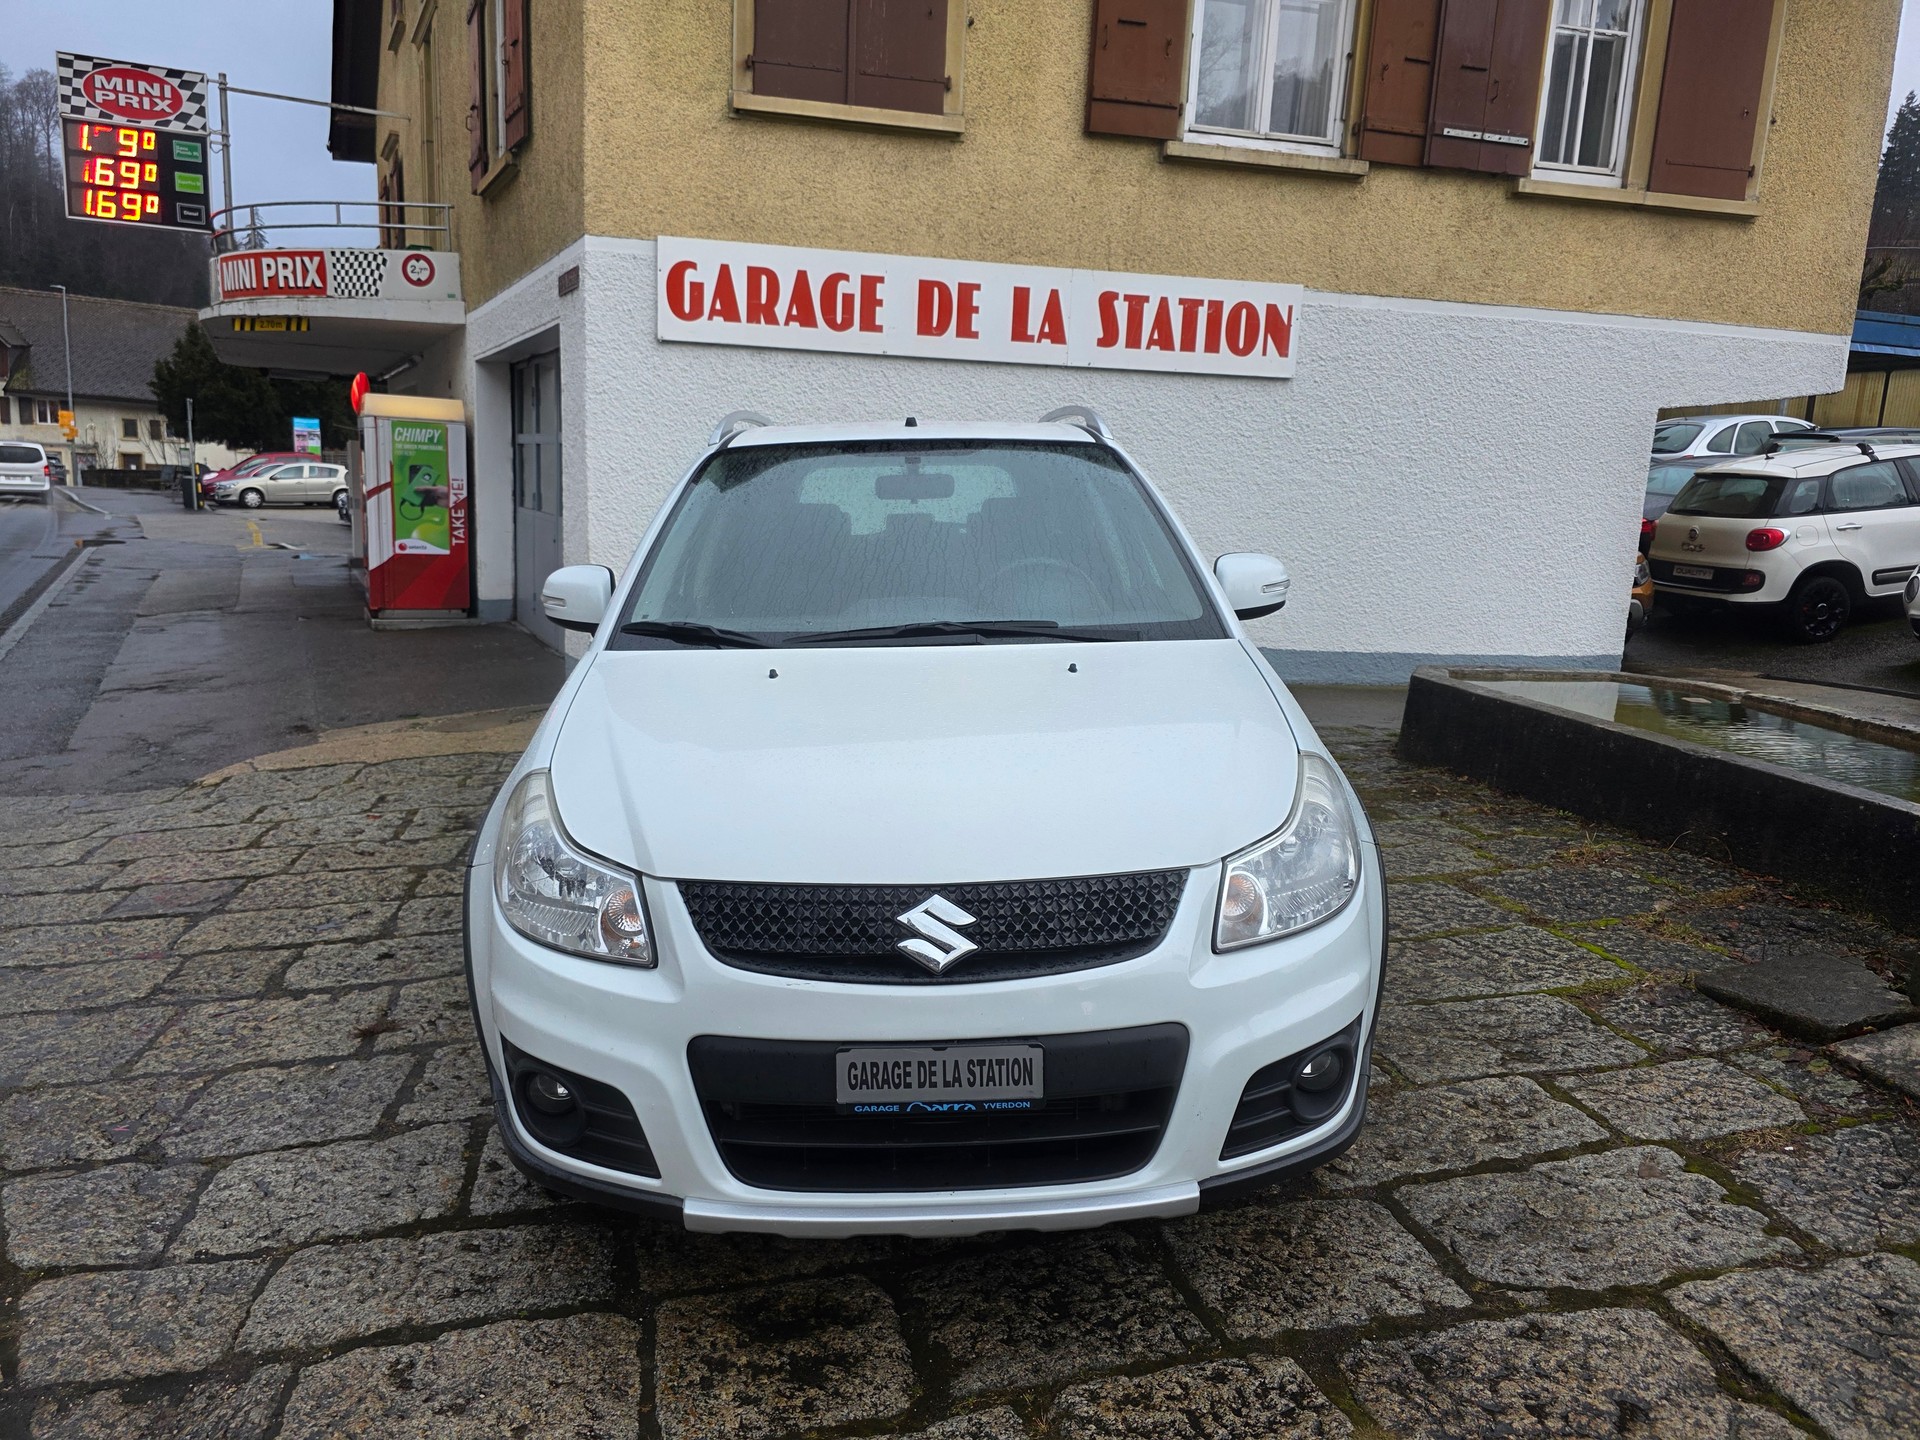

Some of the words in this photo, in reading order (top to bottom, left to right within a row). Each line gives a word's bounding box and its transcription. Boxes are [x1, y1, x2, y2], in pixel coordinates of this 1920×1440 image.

[94, 74, 172, 98] MINI
[95, 90, 173, 113] PRIX
[222, 257, 257, 292] MINI
[261, 256, 323, 289] PRIX
[665, 260, 886, 334] GARAGE
[917, 279, 982, 340] DE
[1010, 286, 1068, 346] LA
[1098, 290, 1294, 359] STATION
[394, 427, 442, 444] CHIMPY
[451, 508, 465, 546] TAKE
[847, 1061, 912, 1090] GARAGE
[917, 1060, 938, 1088] DE
[942, 1059, 962, 1088] LA
[967, 1057, 1034, 1087] STATION
[983, 1101, 1031, 1109] YVERDON
